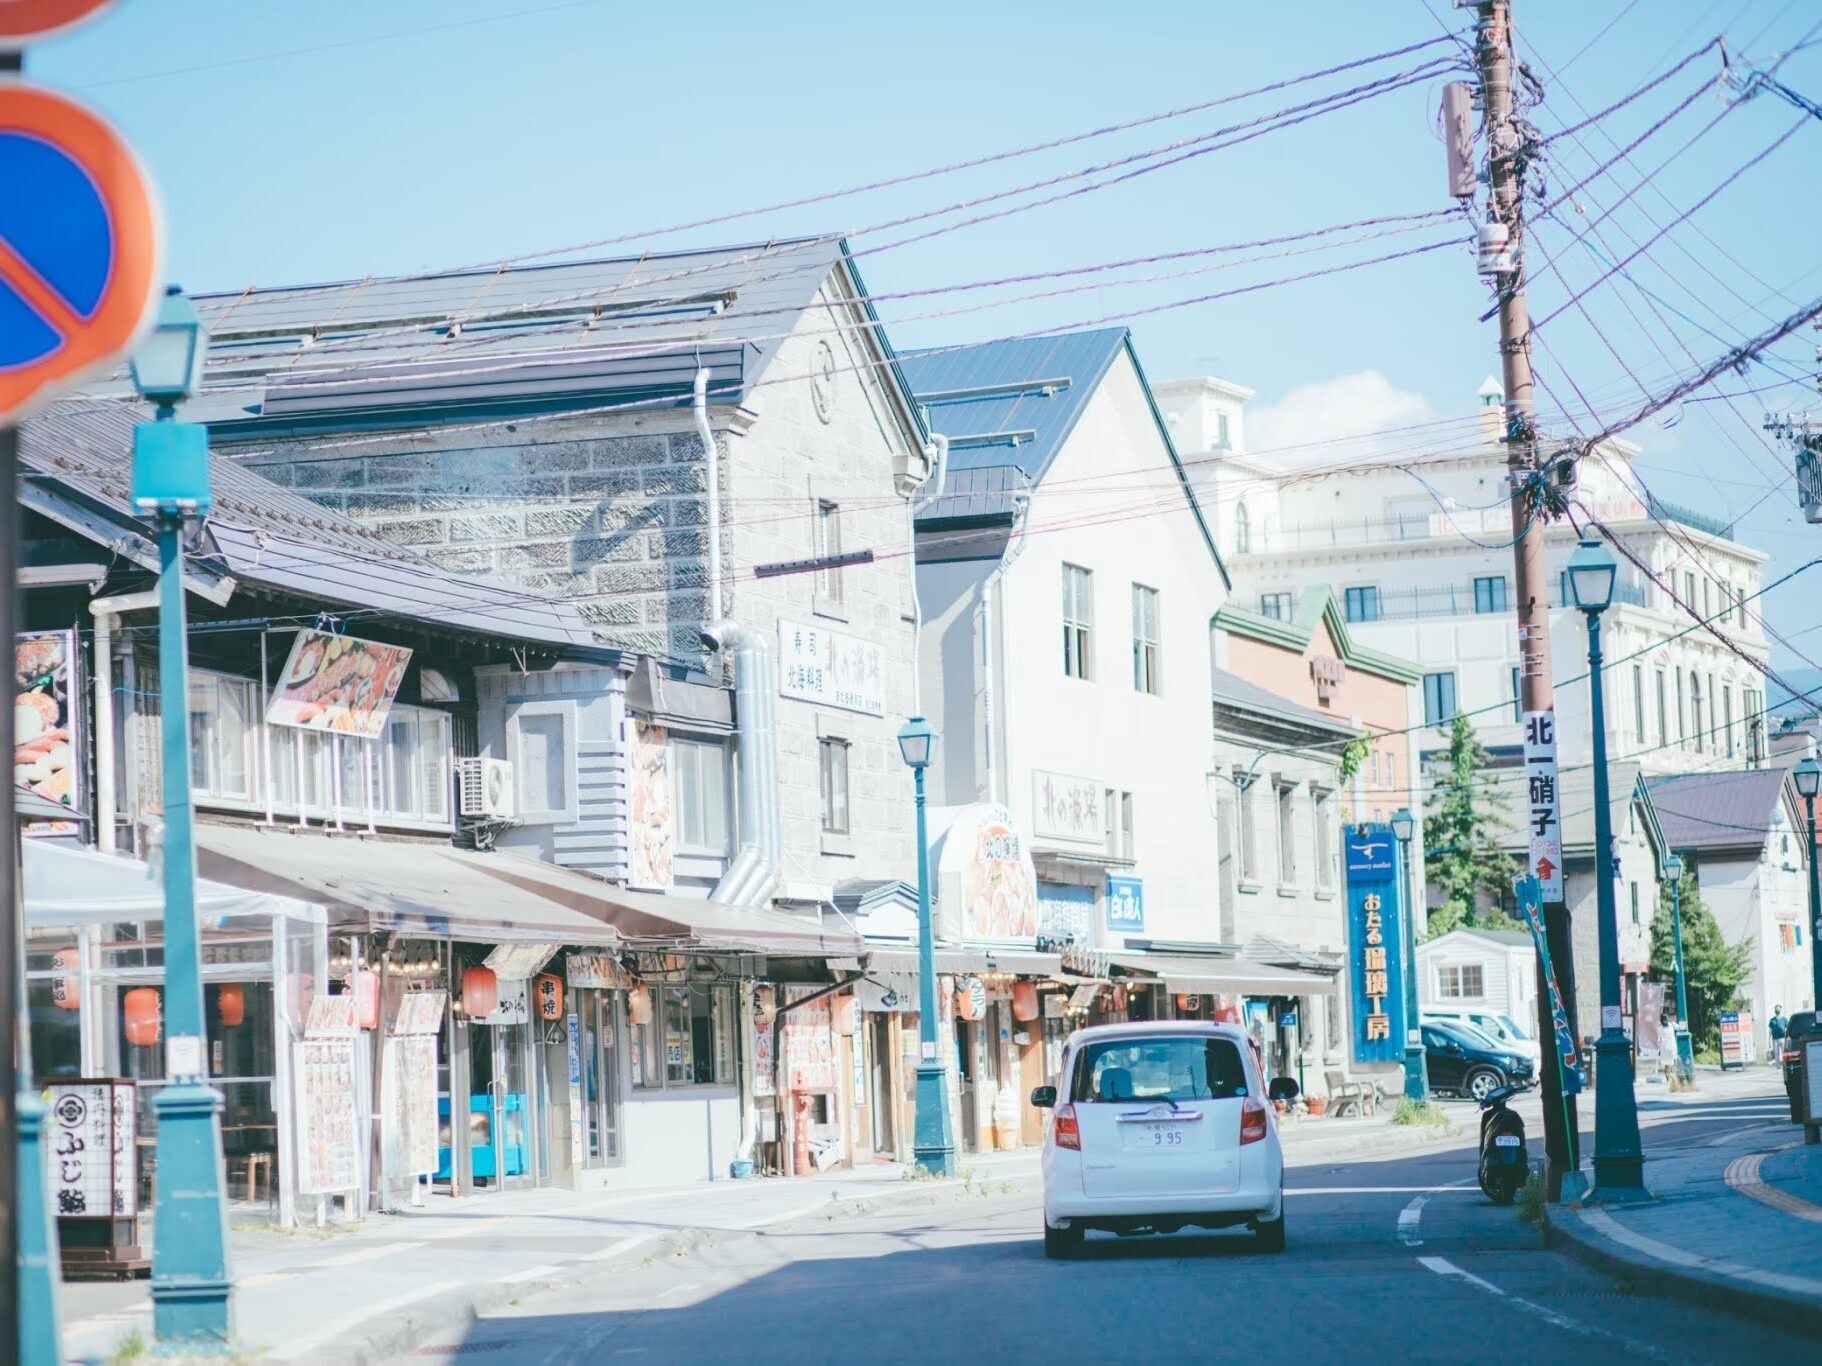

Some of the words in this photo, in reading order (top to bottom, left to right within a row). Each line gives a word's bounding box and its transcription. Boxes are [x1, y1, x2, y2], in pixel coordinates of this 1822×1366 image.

[1526, 716, 1557, 838] 北一硝子
[541, 980, 557, 1015] 串焼
[1364, 893, 1390, 1041] おたる瑠璃工房
[56, 1131, 87, 1214] ふじ鮨
